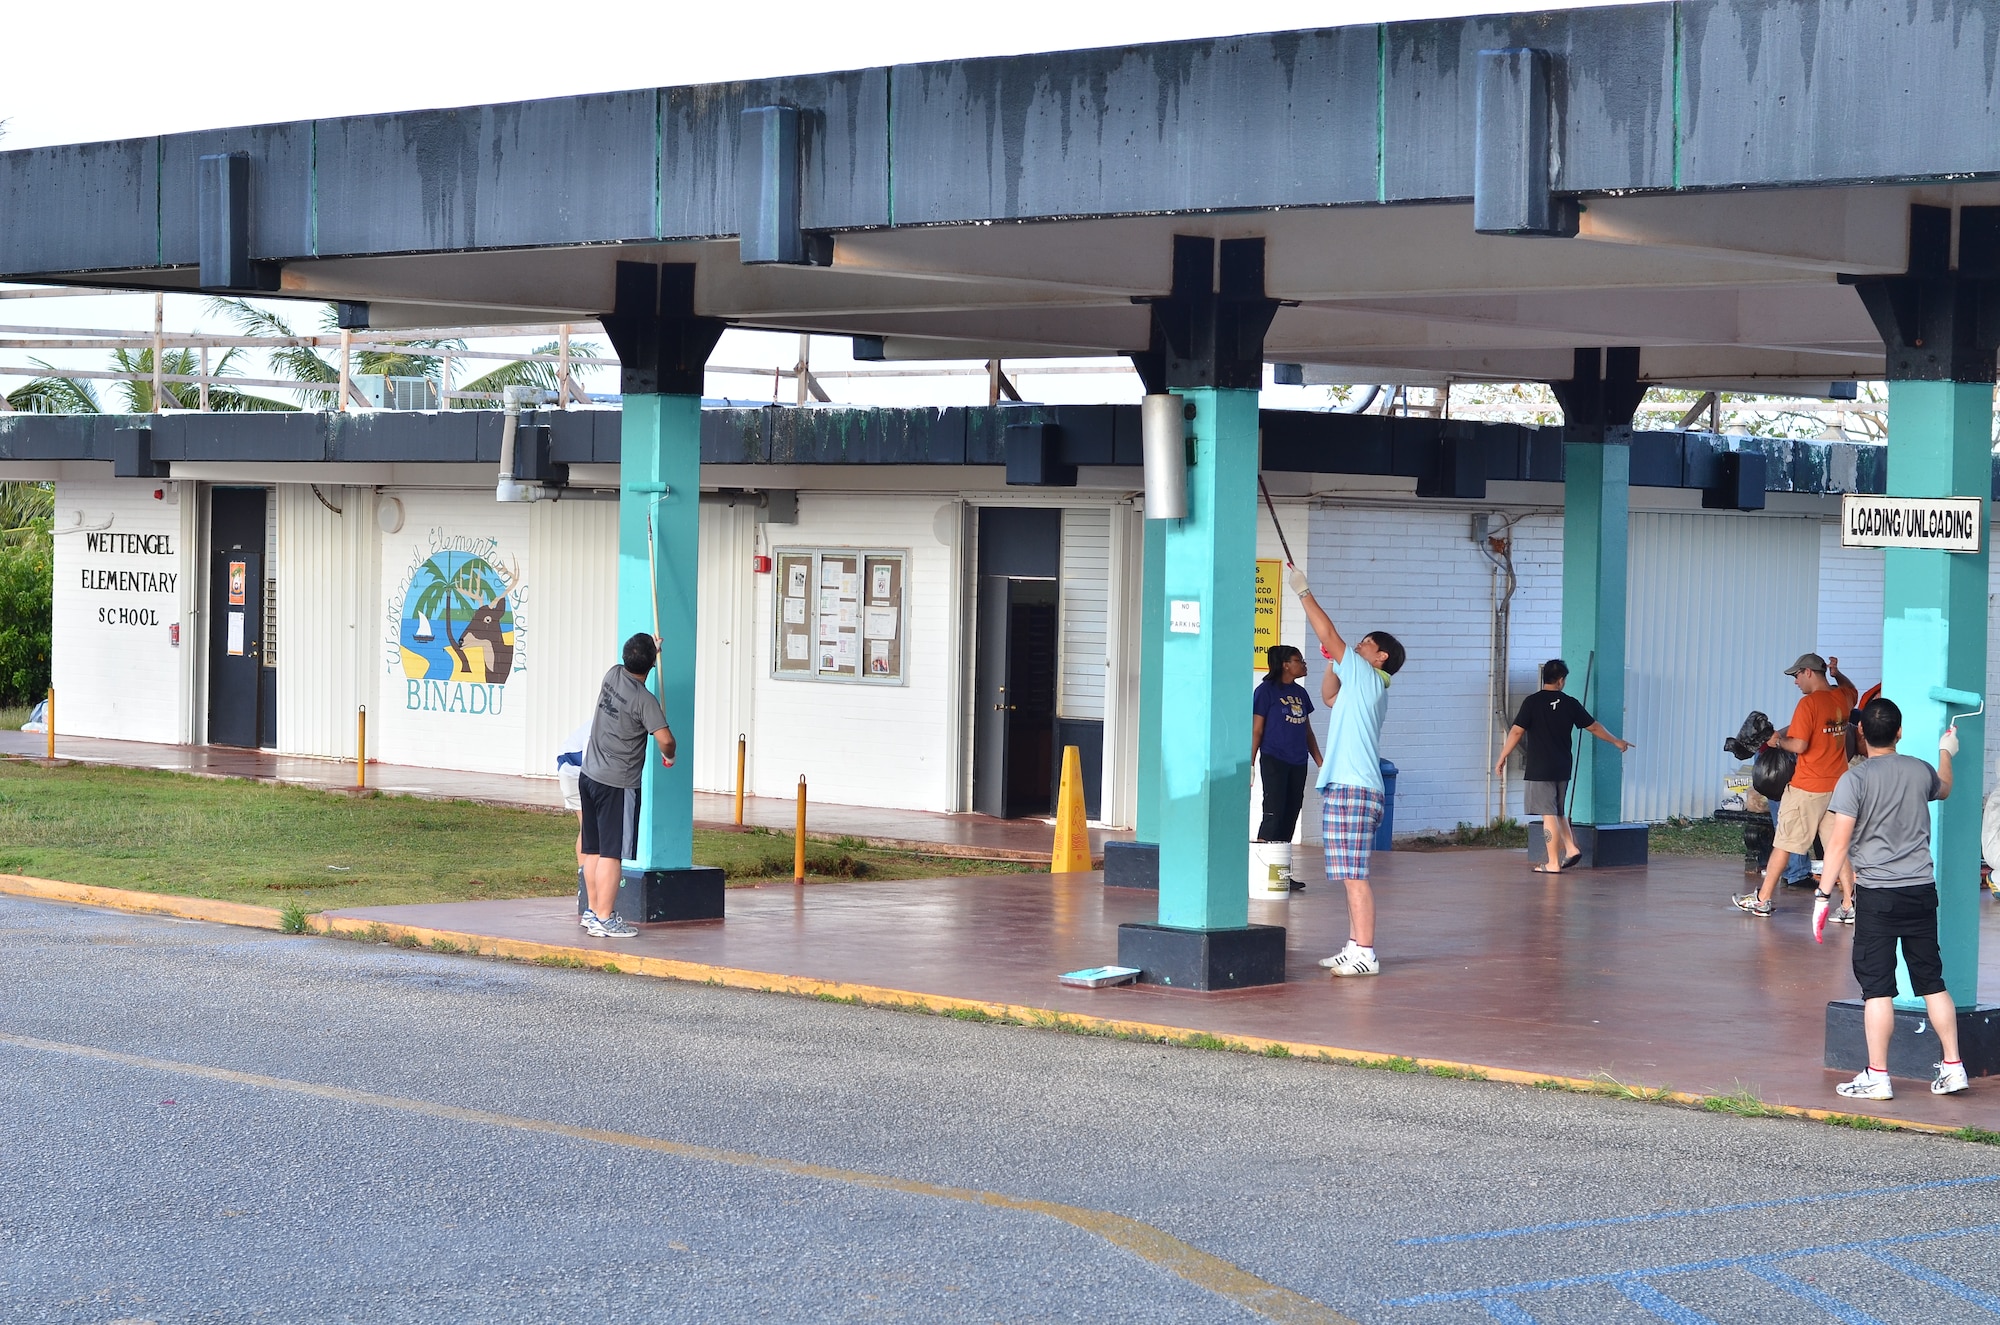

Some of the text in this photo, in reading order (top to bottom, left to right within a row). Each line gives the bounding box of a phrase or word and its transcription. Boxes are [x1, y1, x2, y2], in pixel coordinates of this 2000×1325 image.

[1851, 507, 1973, 539] LOADING/UNLOADING
[86, 533, 174, 554] WETTENGEL
[81, 569, 178, 593] ELEMENTARY
[1254, 607, 1274, 615] PONS
[1255, 597, 1277, 605] KING)
[98, 607, 159, 626] SCHOOL
[512, 585, 529, 673] School
[1254, 627, 1271, 635] HOL
[1253, 646, 1269, 654] MPU
[406, 679, 505, 715] BINADU
